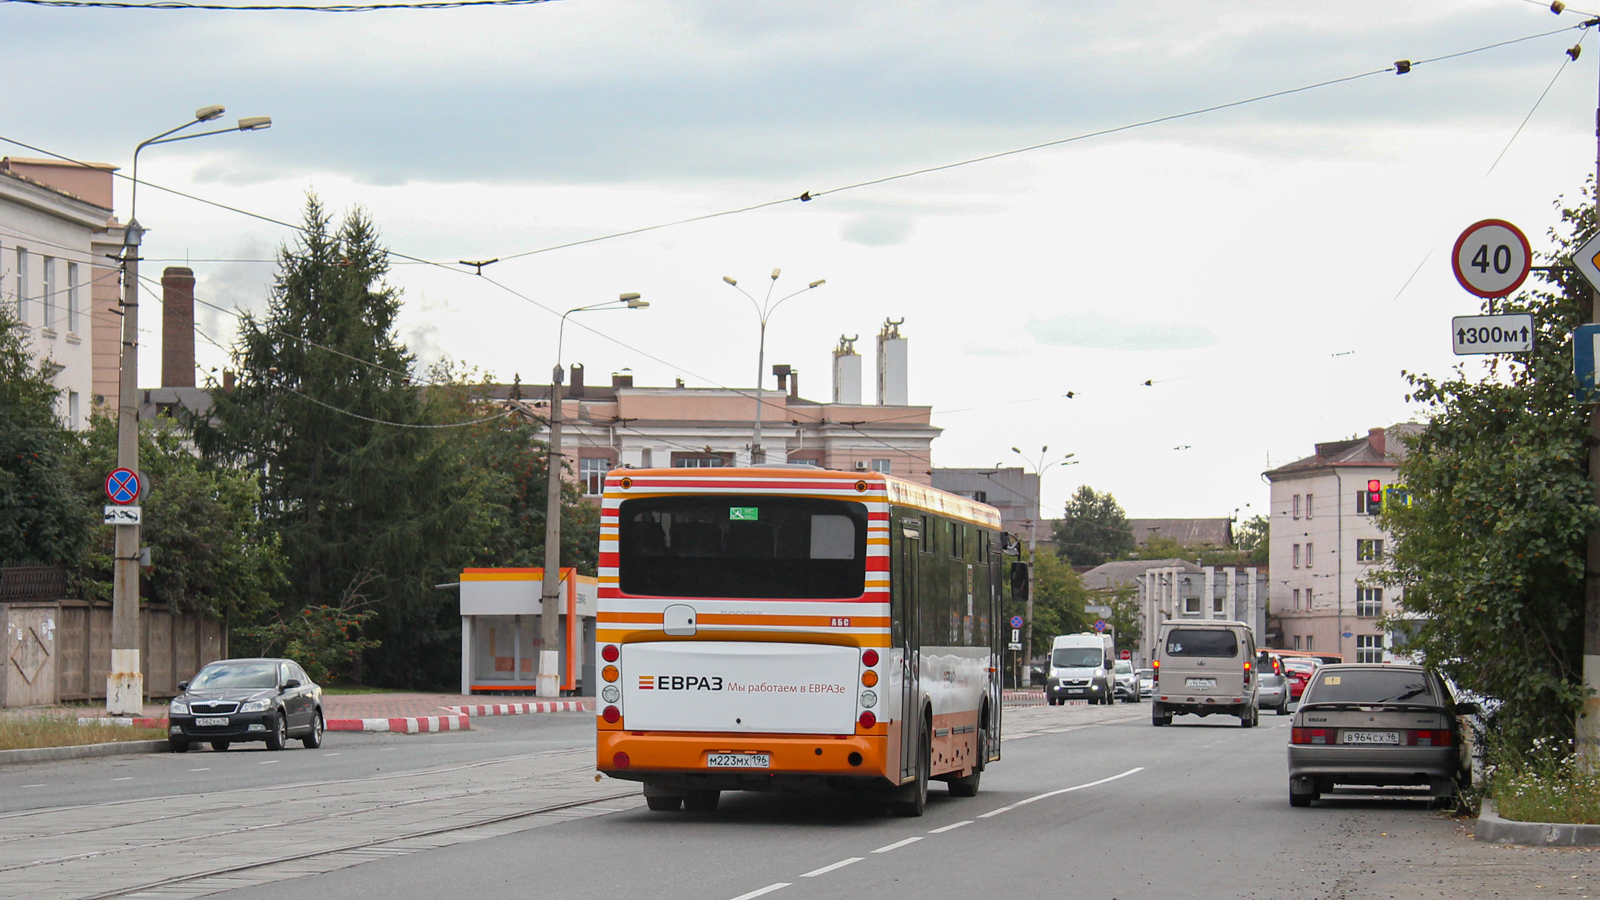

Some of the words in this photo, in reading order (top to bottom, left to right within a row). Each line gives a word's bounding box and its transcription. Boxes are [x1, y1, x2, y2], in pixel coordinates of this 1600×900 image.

[1471, 244, 1512, 275] 40
[1466, 326, 1518, 344] 300м
[831, 618, 850, 627] АБС
[658, 676, 723, 691] ЕВРАЗ
[727, 682, 746, 692] Мы
[748, 682, 797, 694] работаем
[800, 685, 806, 693] в
[808, 683, 846, 694] ЕВРАЗе
[1347, 732, 1384, 742] В964СХ
[1386, 732, 1395, 740] 96
[709, 755, 750, 767] М223МХ
[751, 755, 768, 764] 196
